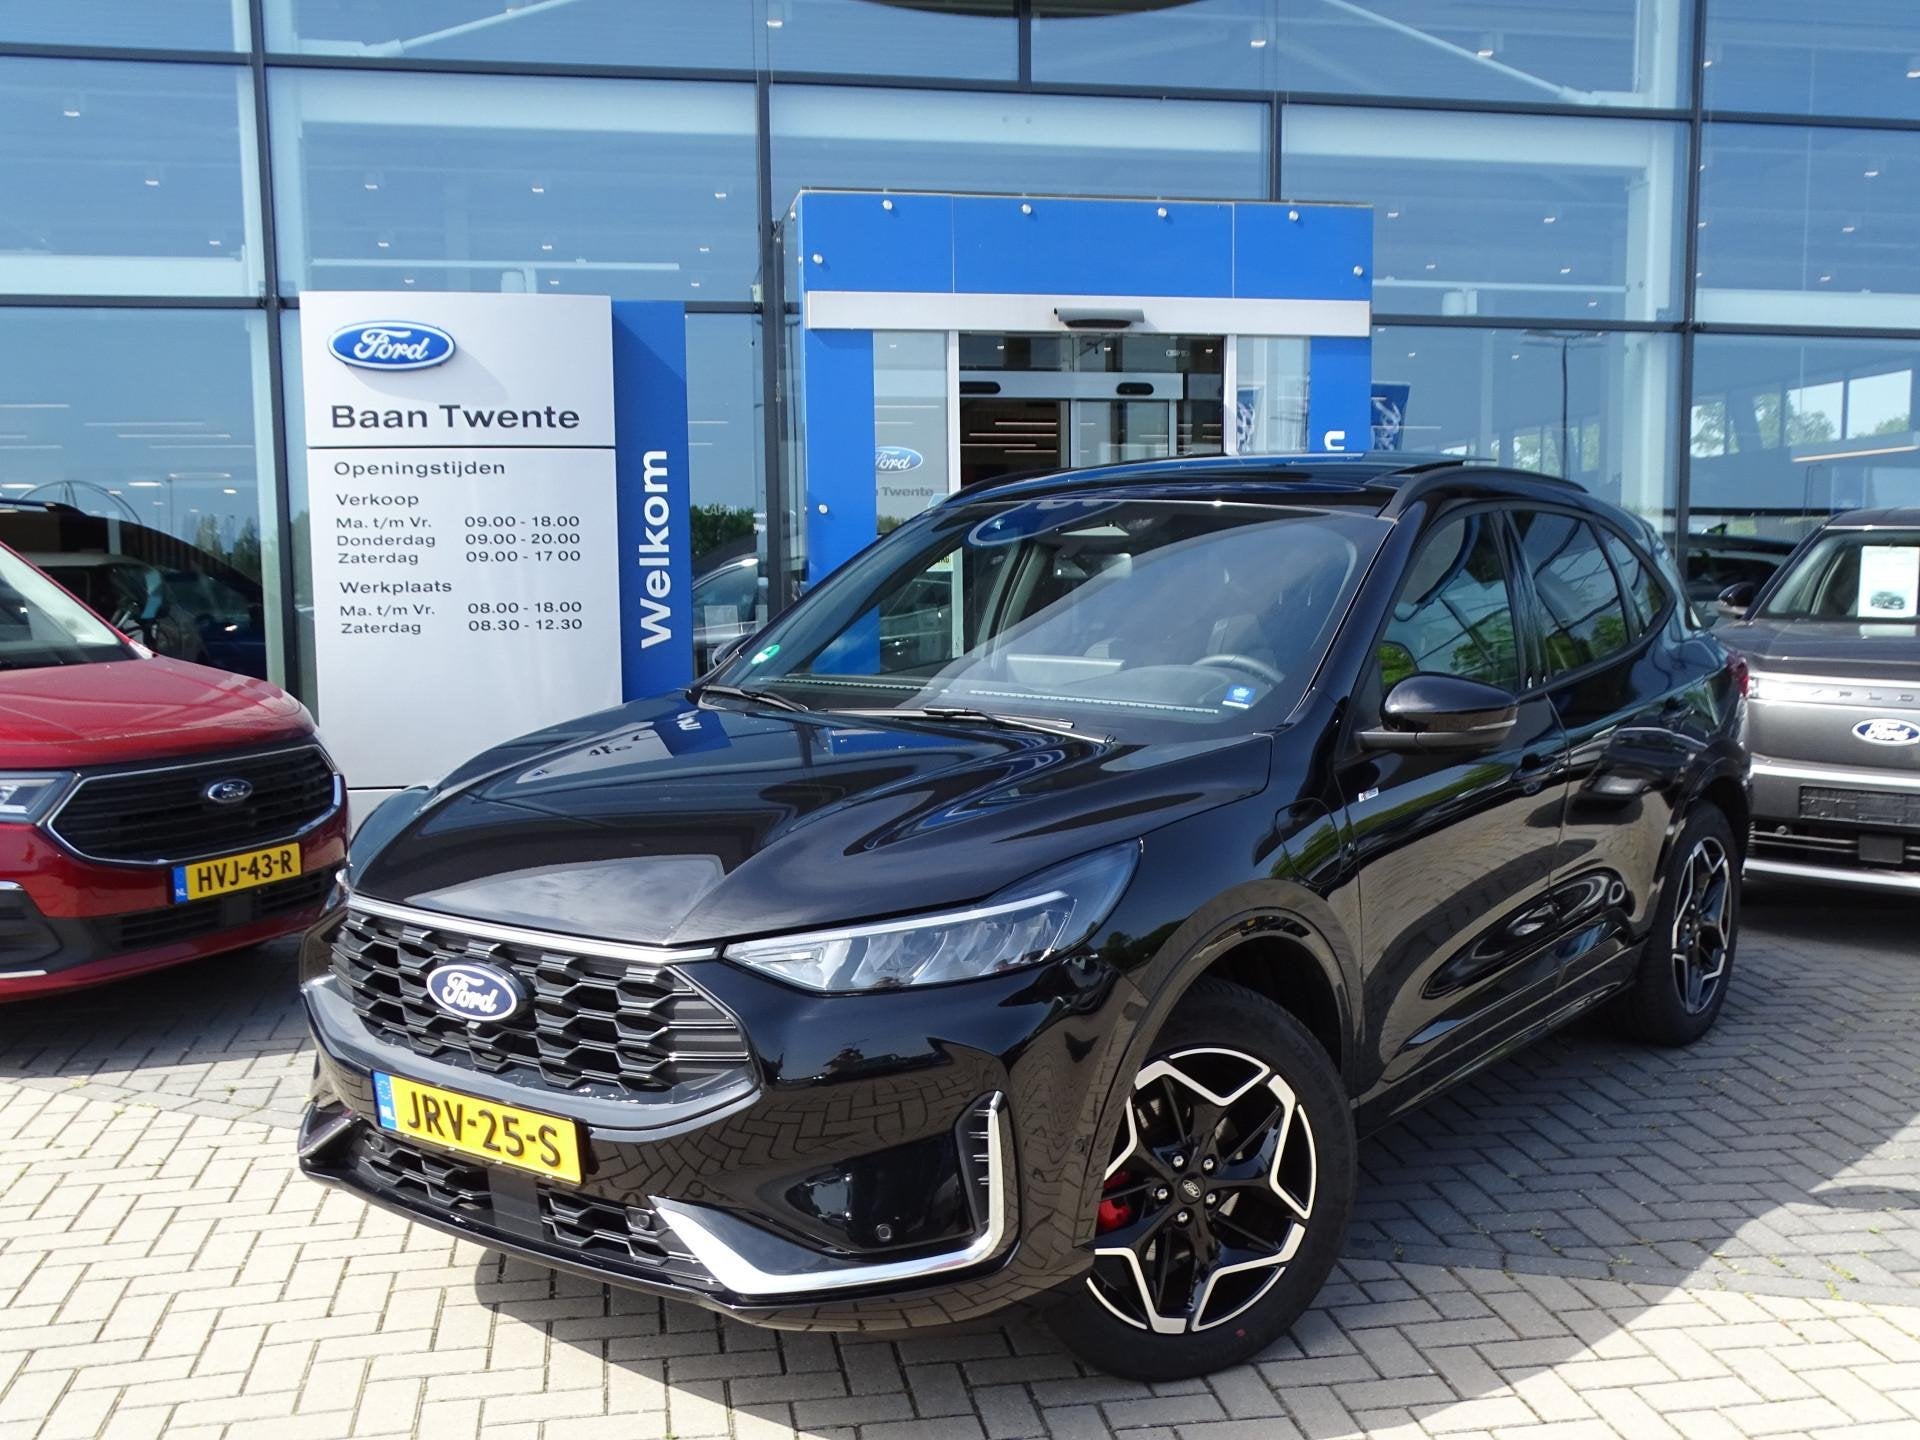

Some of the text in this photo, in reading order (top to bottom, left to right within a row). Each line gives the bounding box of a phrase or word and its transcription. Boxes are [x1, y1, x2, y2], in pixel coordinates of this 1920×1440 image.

[353, 328, 430, 360] Ford
[331, 404, 580, 429] Baan Twente
[334, 461, 505, 478] Openingstijden
[882, 486, 934, 497] Twente
[335, 493, 419, 508] Verkoop
[336, 516, 368, 529] Ma.
[373, 516, 404, 530] t/m
[409, 515, 432, 528] Vr.
[464, 515, 516, 528] 09.00
[531, 515, 580, 527] 18.00
[337, 534, 436, 549] Donderdag
[465, 533, 517, 545] 09.00
[531, 532, 581, 545] 20.00
[338, 551, 419, 566] Zaterdag
[466, 550, 518, 563] 09.00
[638, 450, 672, 649] Welkom
[339, 580, 452, 596] Werkplaats
[340, 605, 372, 617] Ma.
[376, 604, 408, 617] t/m
[412, 603, 436, 616] Vr.
[467, 602, 519, 614] 08.00
[535, 601, 582, 613] 18.00
[341, 621, 422, 636] Zaterdag
[468, 619, 520, 632] 08.30
[536, 618, 583, 631] 12.30
[197, 849, 293, 893] HVJ-43-R
[442, 971, 498, 1014] Ford
[407, 1091, 561, 1168] JRV-25-S
